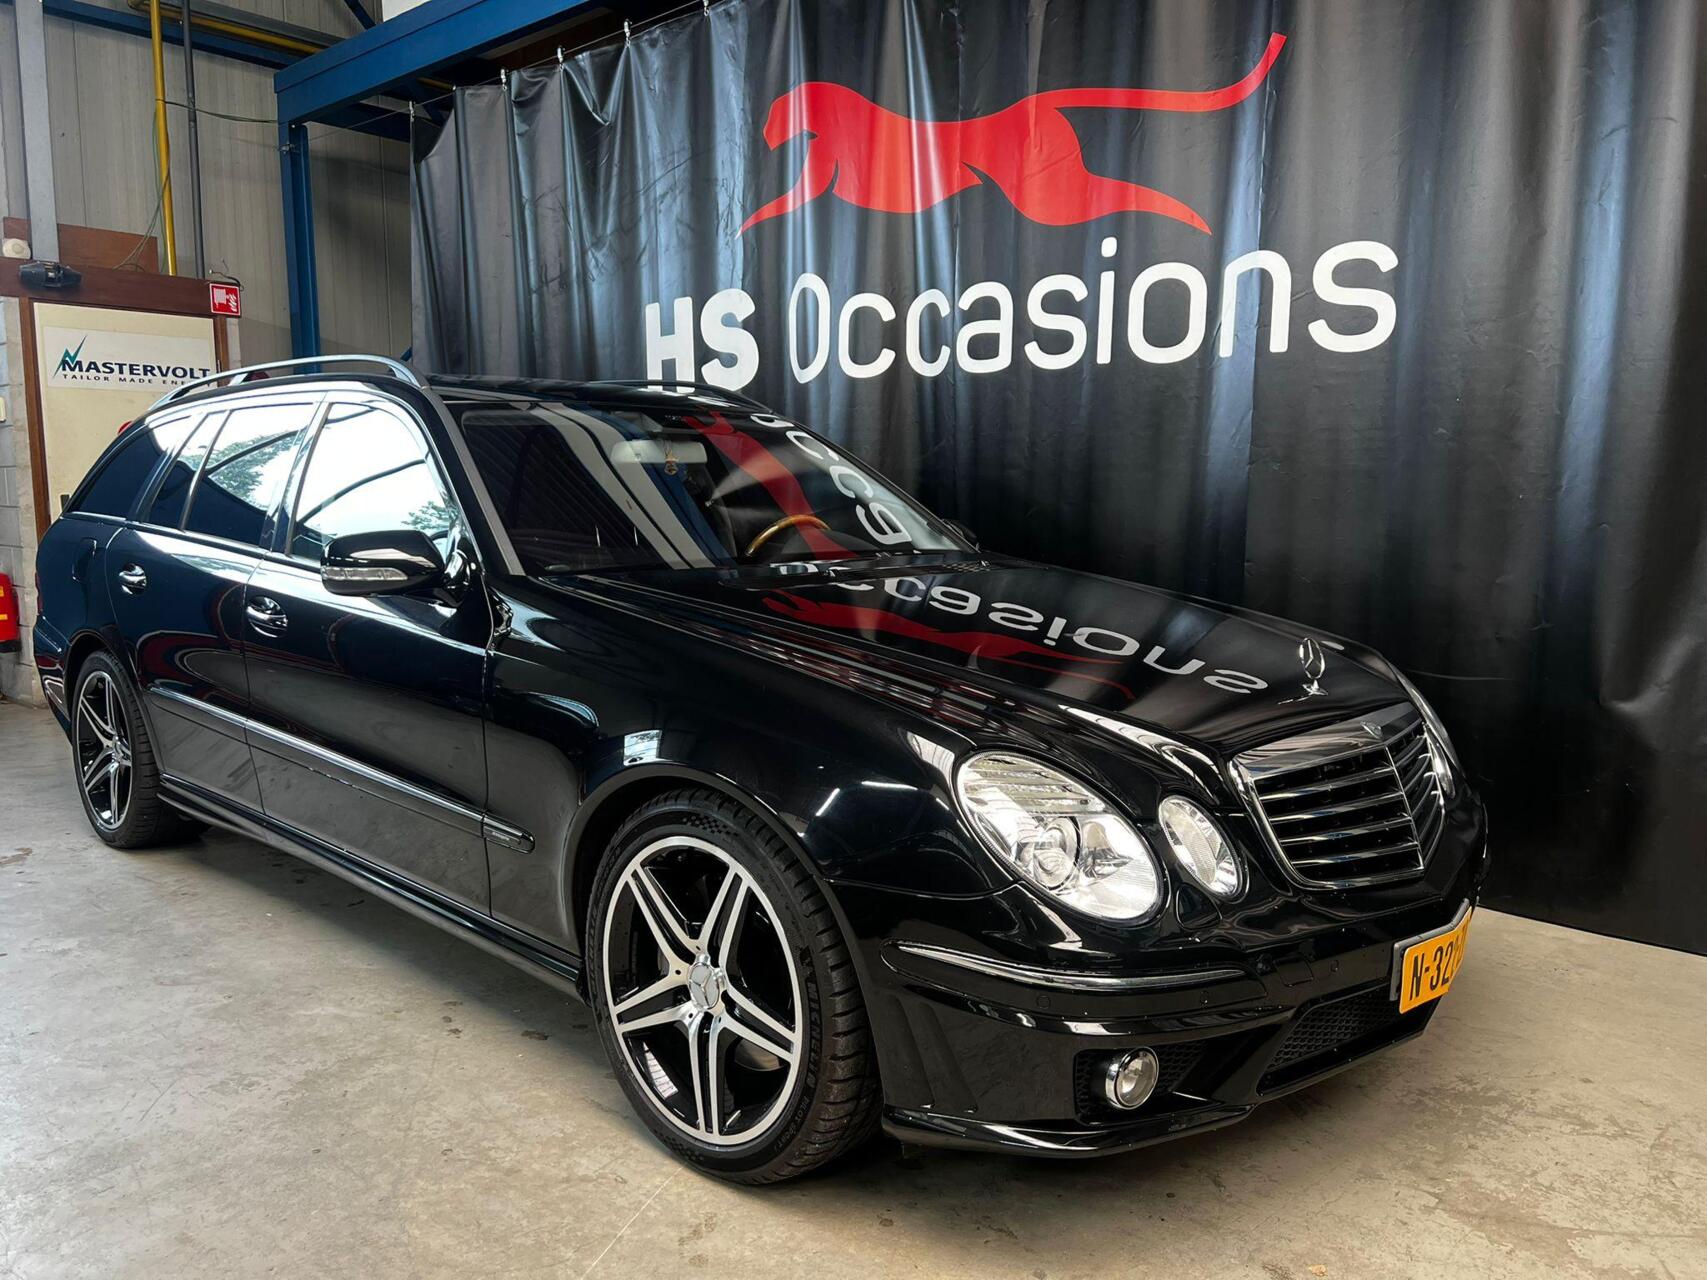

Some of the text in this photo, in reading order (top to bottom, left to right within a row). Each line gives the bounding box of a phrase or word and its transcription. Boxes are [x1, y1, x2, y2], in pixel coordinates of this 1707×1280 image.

[645, 237, 1399, 393] HS Occasions
[61, 361, 210, 379] MASTERVOLT
